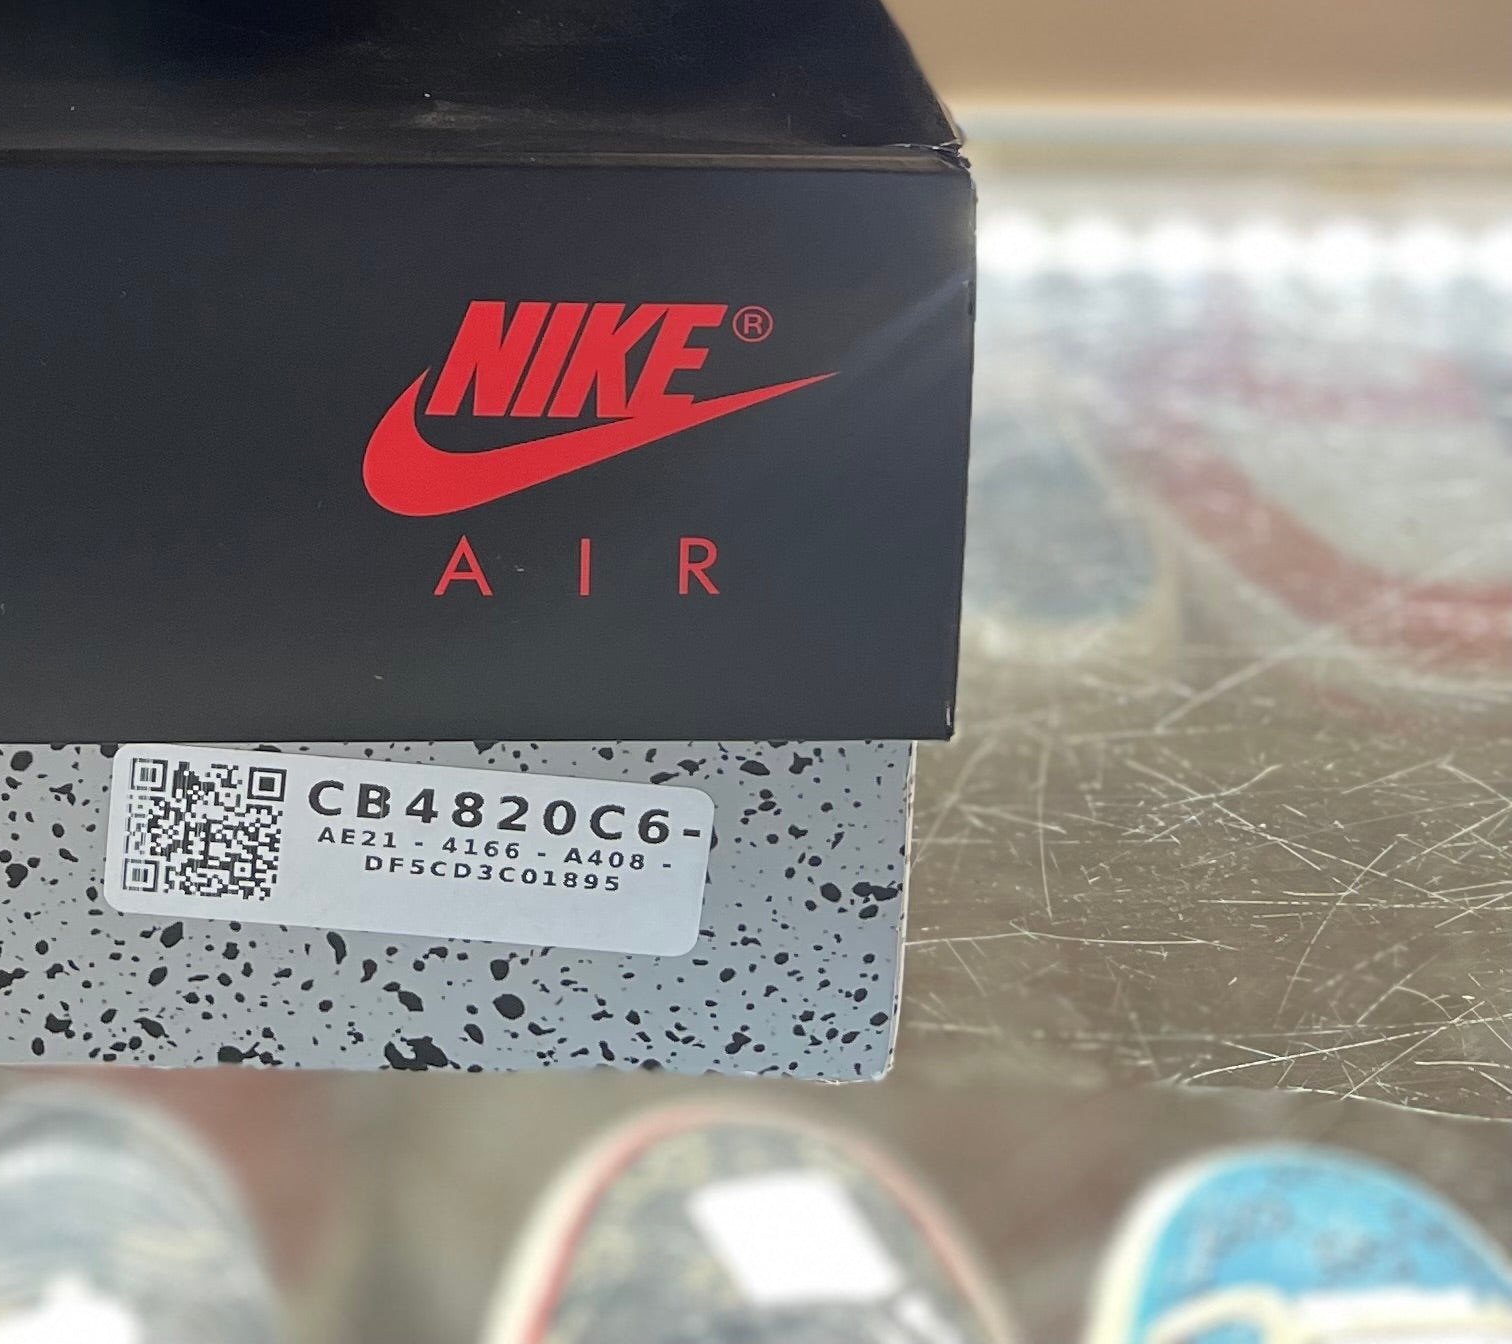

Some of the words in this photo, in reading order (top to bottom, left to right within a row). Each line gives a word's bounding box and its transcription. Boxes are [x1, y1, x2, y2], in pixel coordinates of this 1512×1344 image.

[425, 299, 728, 418] NIKE
[433, 534, 721, 597] AIR
[307, 778, 702, 845] CB4820C6-
[317, 825, 398, 850] AE21
[440, 835, 521, 861] 4166
[562, 845, 646, 872] A408
[364, 855, 621, 893] DF5CD3C01895
